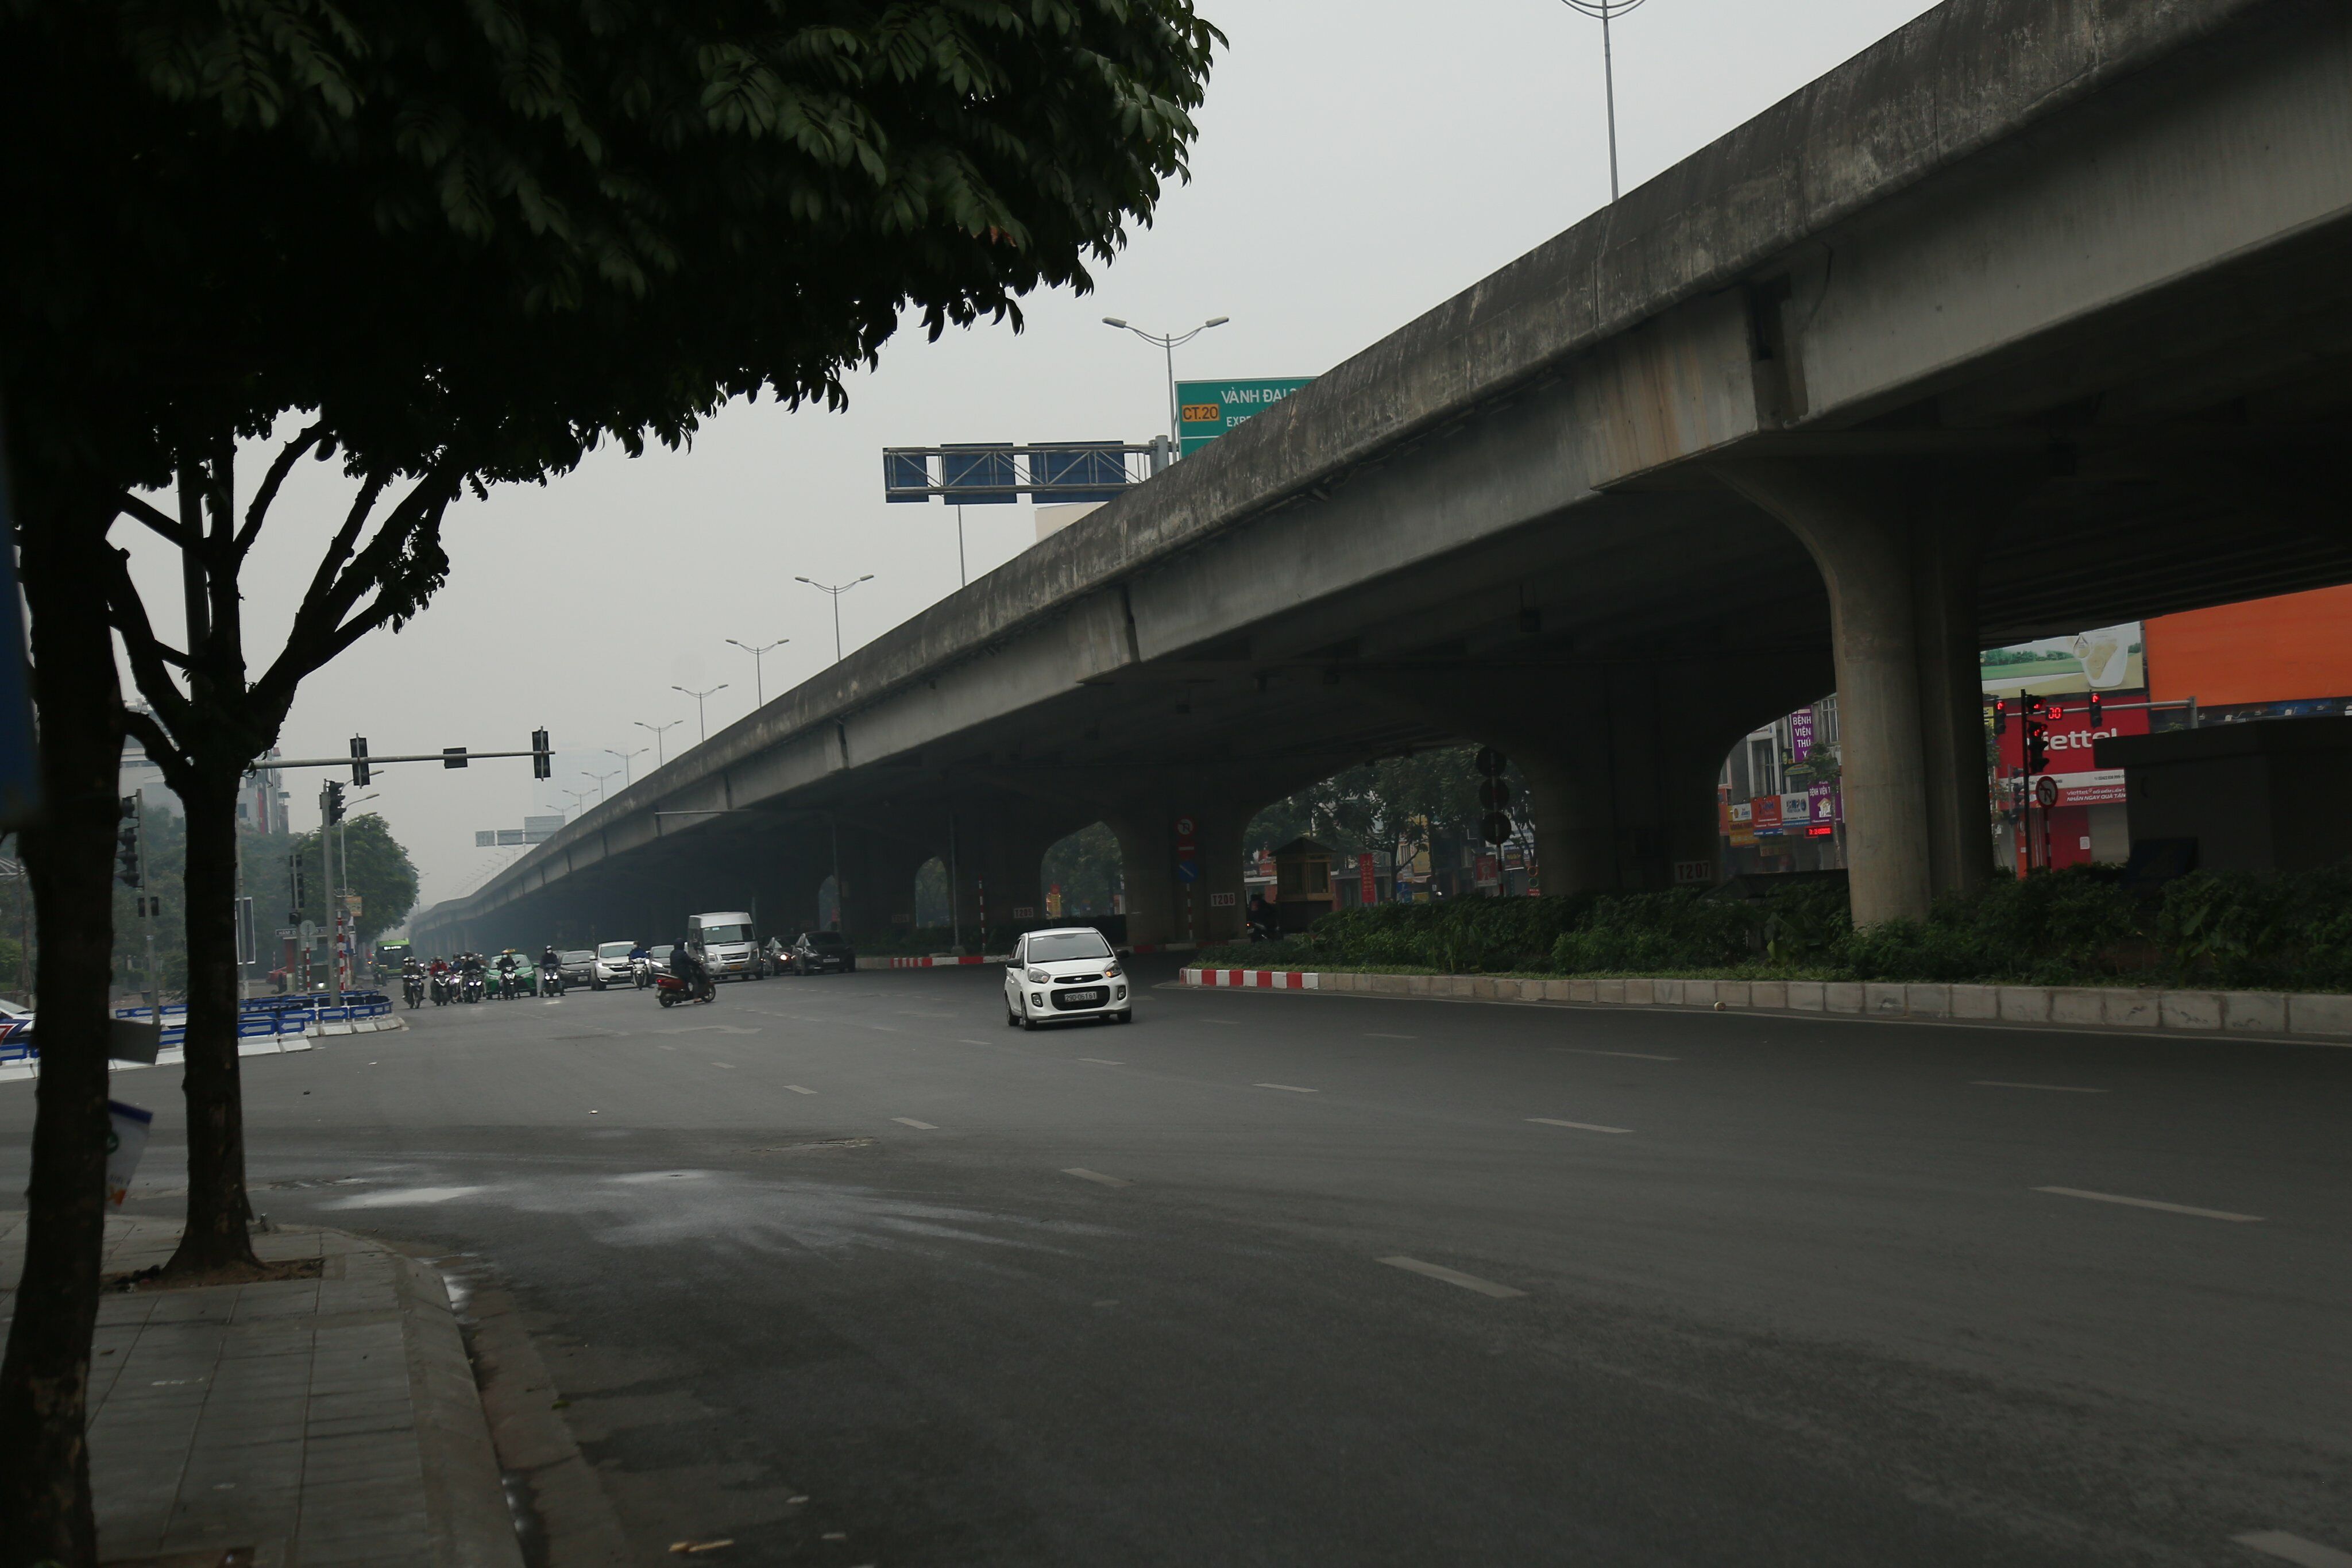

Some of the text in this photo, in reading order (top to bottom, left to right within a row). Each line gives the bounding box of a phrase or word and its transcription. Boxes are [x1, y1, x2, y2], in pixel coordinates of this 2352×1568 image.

[1221, 387, 1286, 404] VÀNH ĐAI
[1182, 406, 1218, 420] CT.20
[1793, 715, 1812, 726] BỆNH
[1795, 725, 1811, 737] VIỆN
[1797, 737, 1811, 748] THÚ
[1677, 863, 1709, 880] T207
[1212, 894, 1234, 906] T206
[1015, 908, 1033, 917] T205
